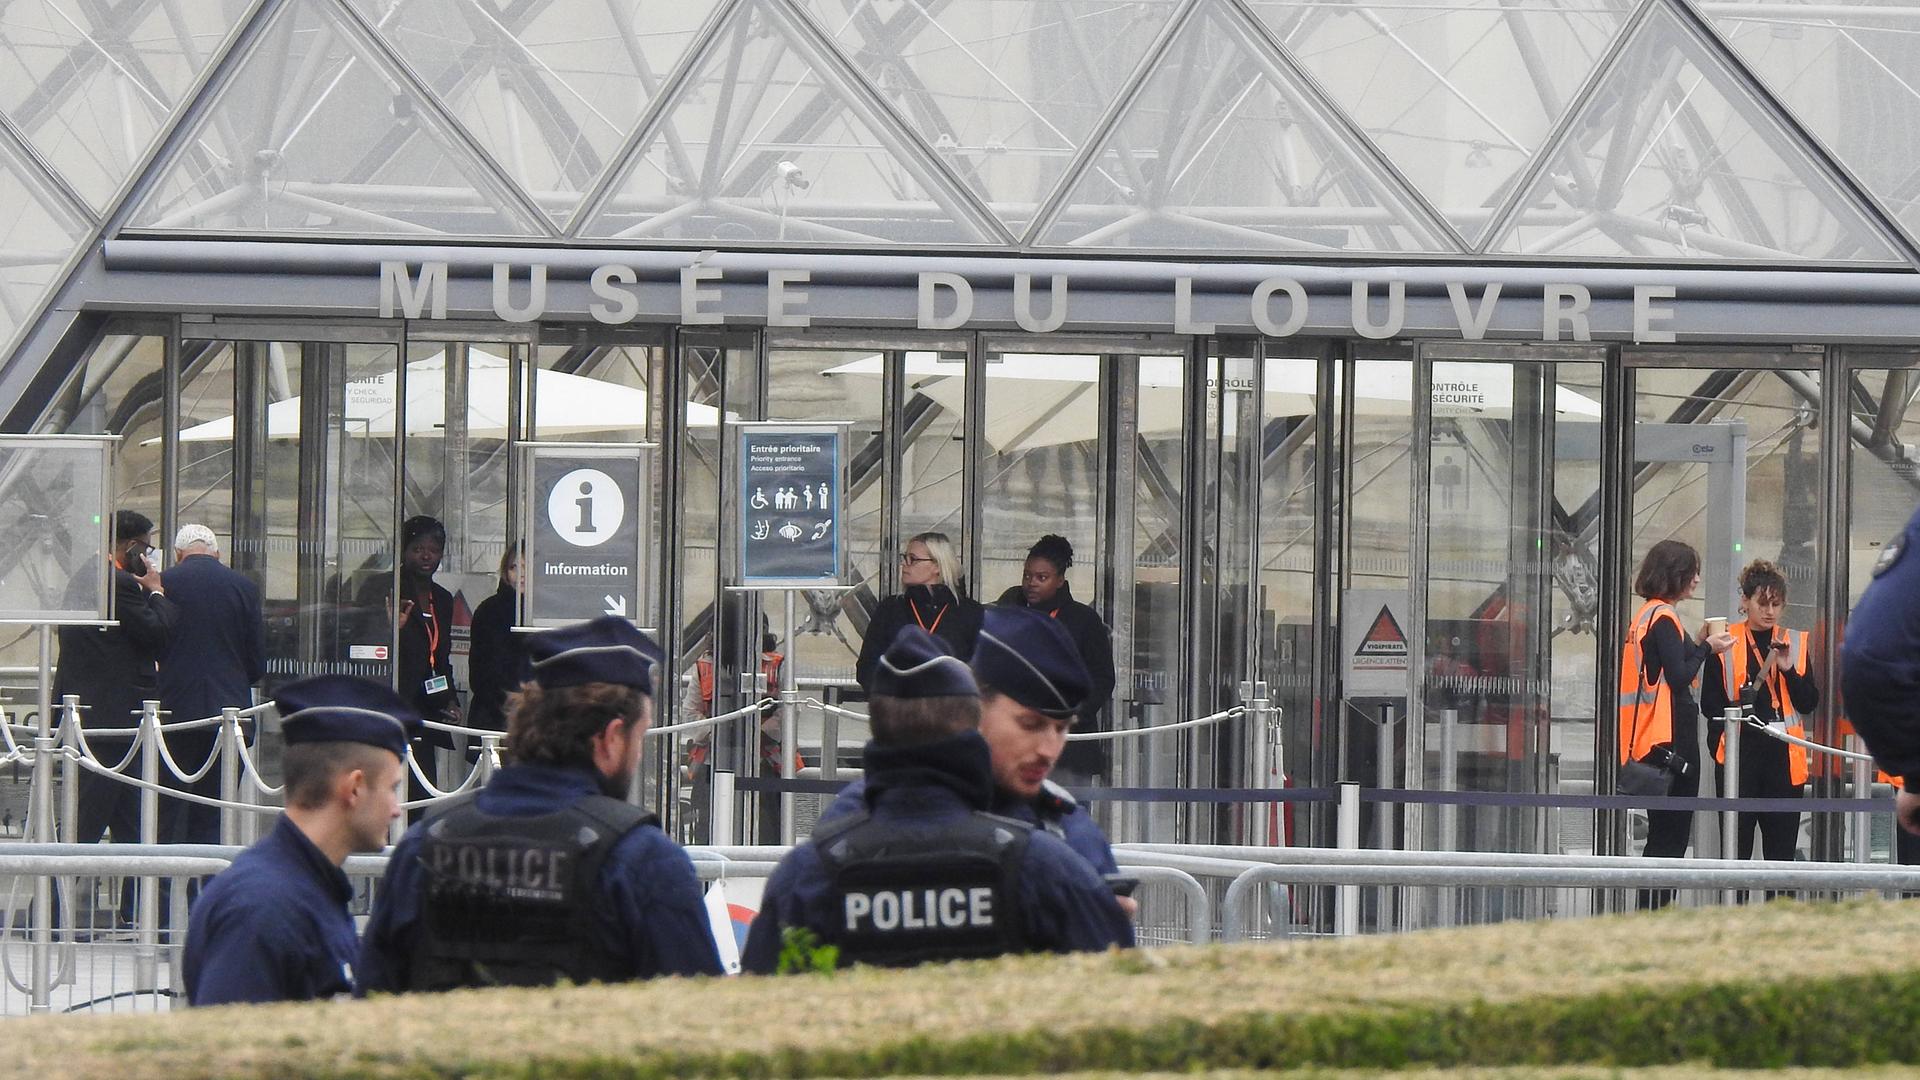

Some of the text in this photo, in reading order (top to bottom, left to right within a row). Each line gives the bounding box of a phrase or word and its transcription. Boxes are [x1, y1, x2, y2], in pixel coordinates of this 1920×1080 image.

[379, 250, 1677, 343] MUSÉE DU LOUVRE
[751, 444, 821, 454] Entrée prioritaire
[545, 562, 628, 576] Information
[433, 845, 568, 889] POLICE
[845, 887, 993, 931] POLICE
